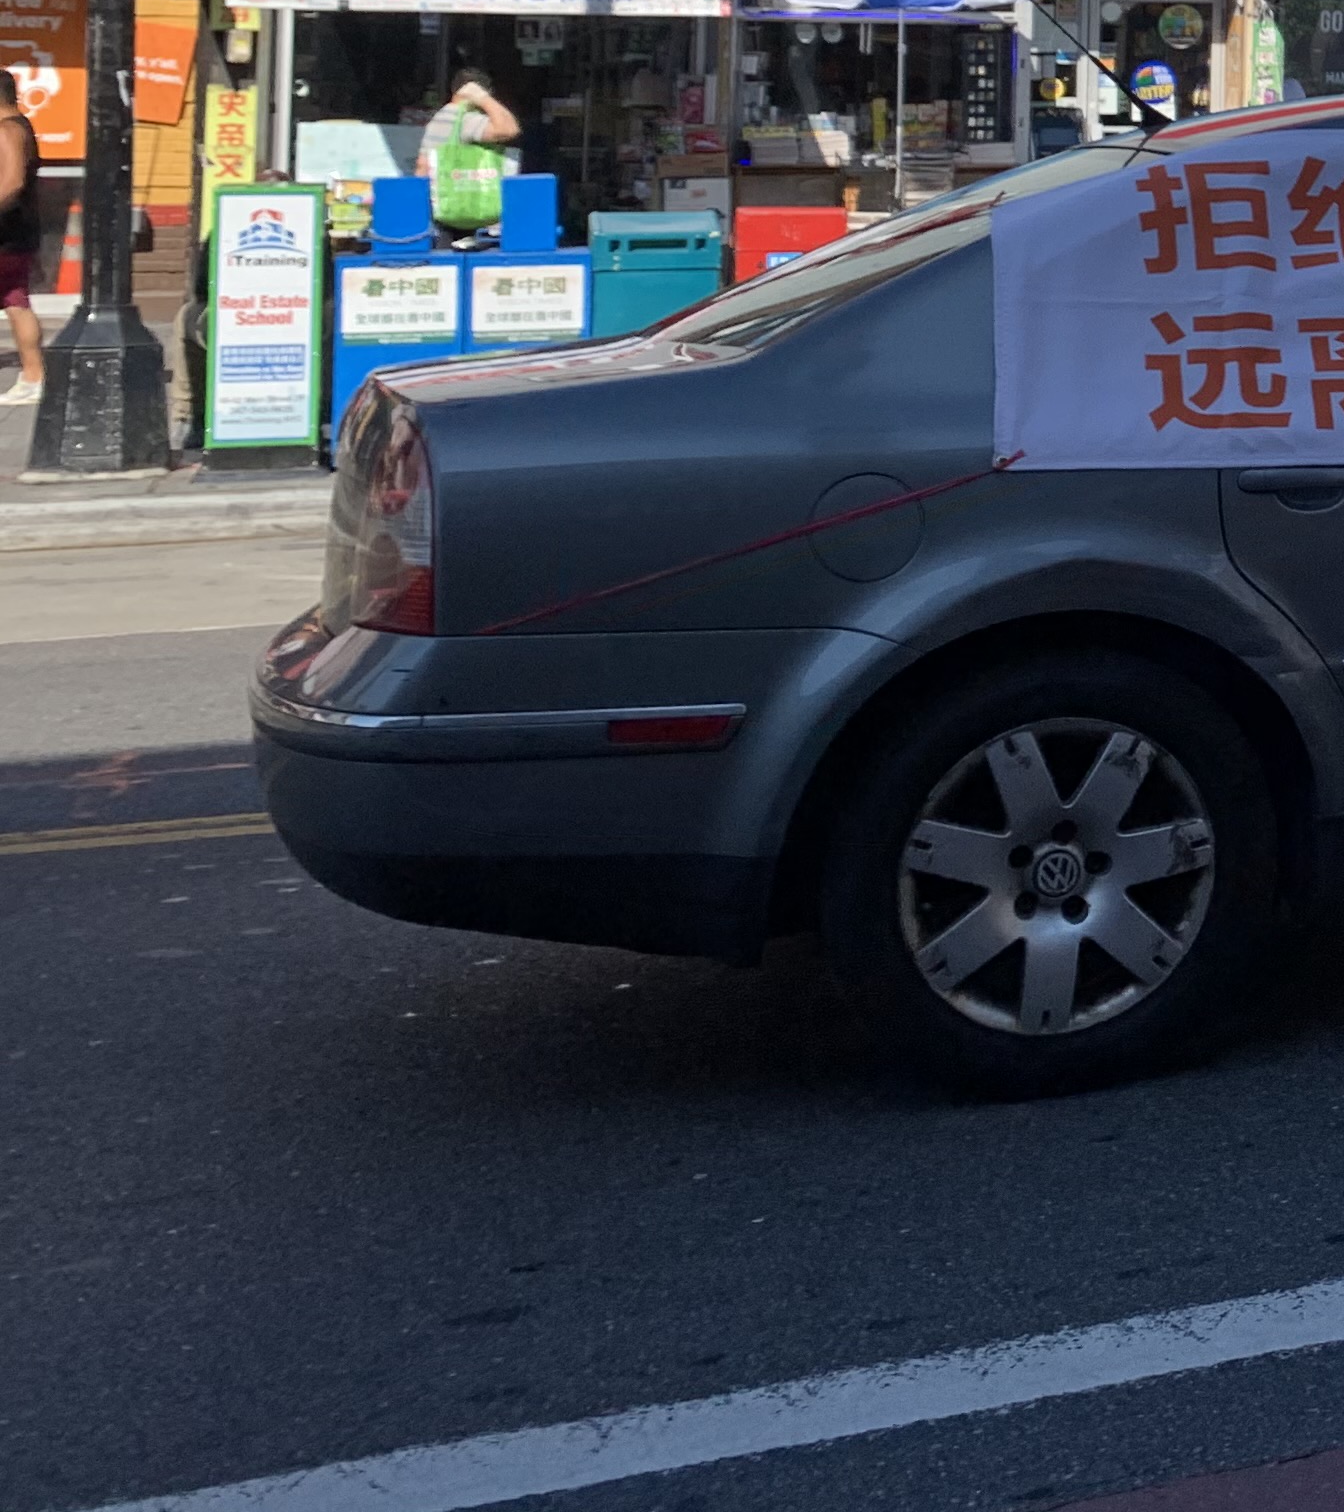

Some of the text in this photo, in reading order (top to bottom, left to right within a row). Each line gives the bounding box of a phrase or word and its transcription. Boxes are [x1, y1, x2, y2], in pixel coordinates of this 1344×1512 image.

[219, 294, 309, 310] Real Estate
[234, 311, 294, 326] School
